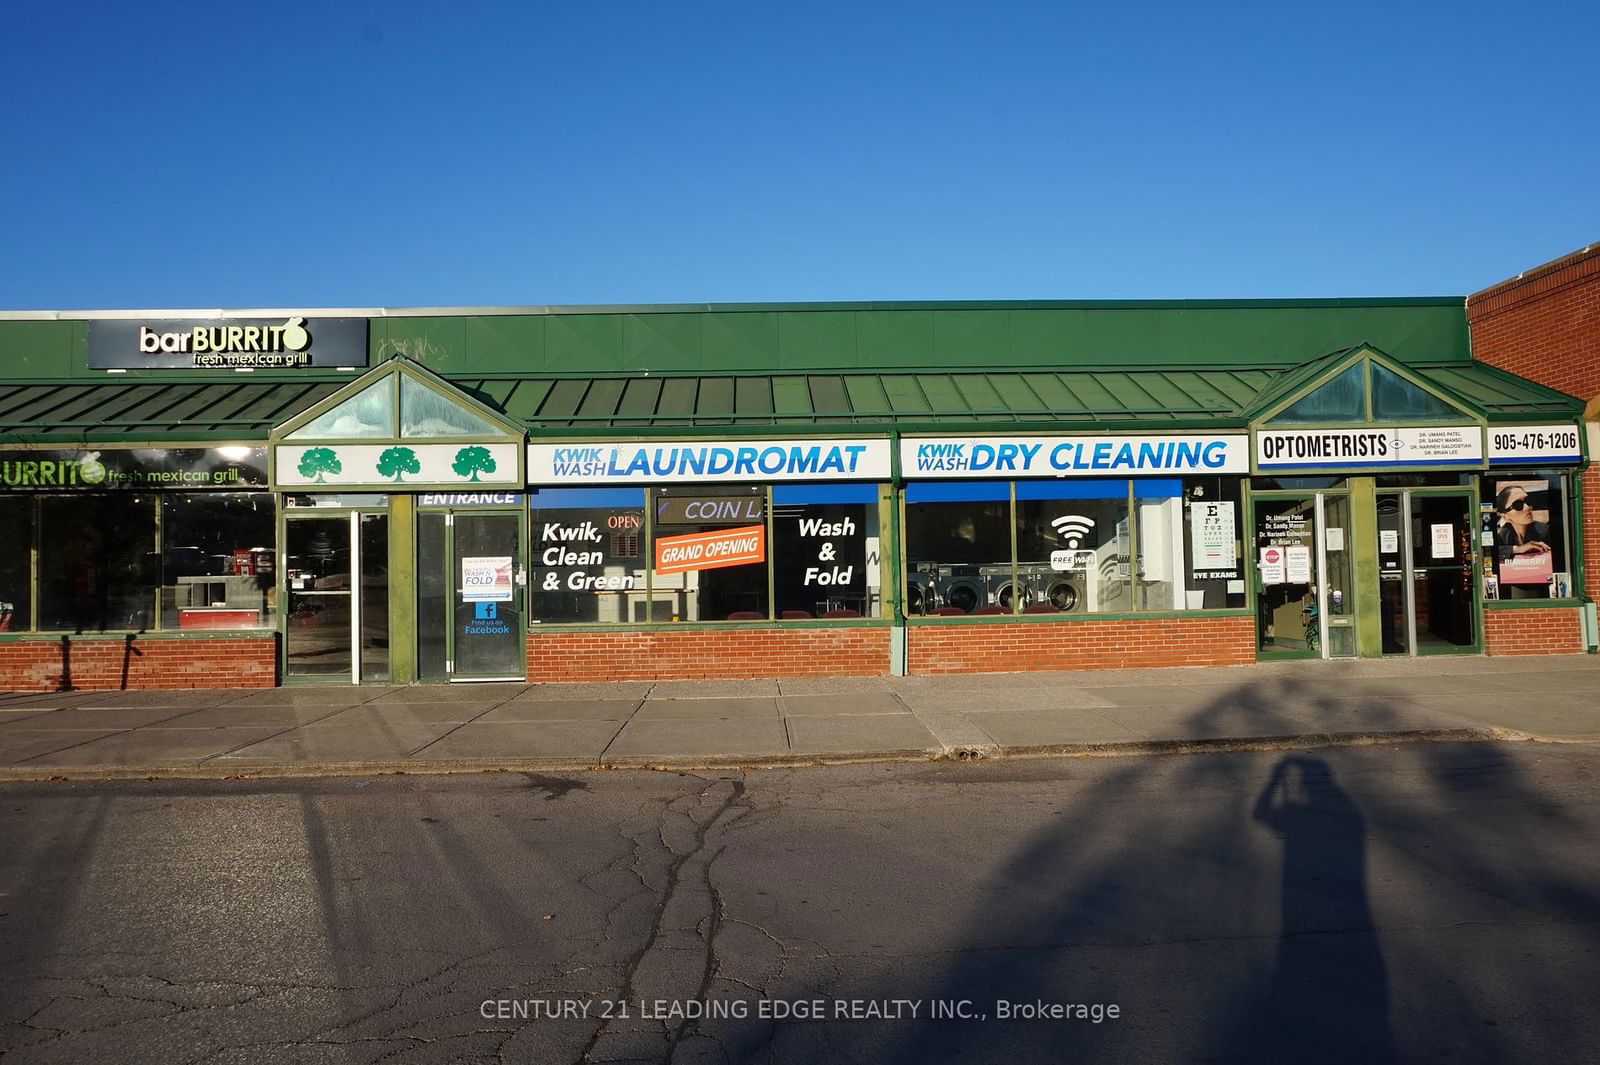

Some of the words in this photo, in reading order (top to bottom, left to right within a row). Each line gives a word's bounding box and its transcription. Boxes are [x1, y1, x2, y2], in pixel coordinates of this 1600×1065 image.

[193, 353, 223, 365] fresh
[227, 353, 282, 365] mexican
[286, 353, 307, 366] grill
[918, 444, 966, 457] KWIK
[1263, 434, 1387, 459] OPTOMETRISTS
[1494, 432, 1577, 451] 905-476-1206
[553, 448, 604, 463] KWIK
[607, 445, 866, 477] LAUNDROMAT
[917, 458, 968, 471] WASH
[969, 442, 1042, 471] DRY
[1049, 441, 1227, 470] CLEANING
[0, 454, 106, 485] URRITO
[109, 470, 142, 482] fresh
[147, 470, 209, 482] mexican
[214, 469, 238, 484] grill
[553, 463, 605, 477] WASH
[423, 494, 515, 505] ENTRANCE
[685, 501, 741, 519] COIN
[1207, 505, 1217, 516] E
[608, 515, 639, 529] OPEN
[799, 517, 855, 537] Wash
[542, 521, 603, 543] Kwik,
[542, 547, 603, 566] Clean
[661, 542, 703, 563] GRAND
[704, 536, 759, 558] OPENING
[818, 542, 836, 561] &
[466, 576, 492, 584] FOLD
[542, 572, 561, 591] &
[567, 572, 634, 590] Green
[804, 565, 853, 586] Fold
[464, 626, 510, 634] Facebook
